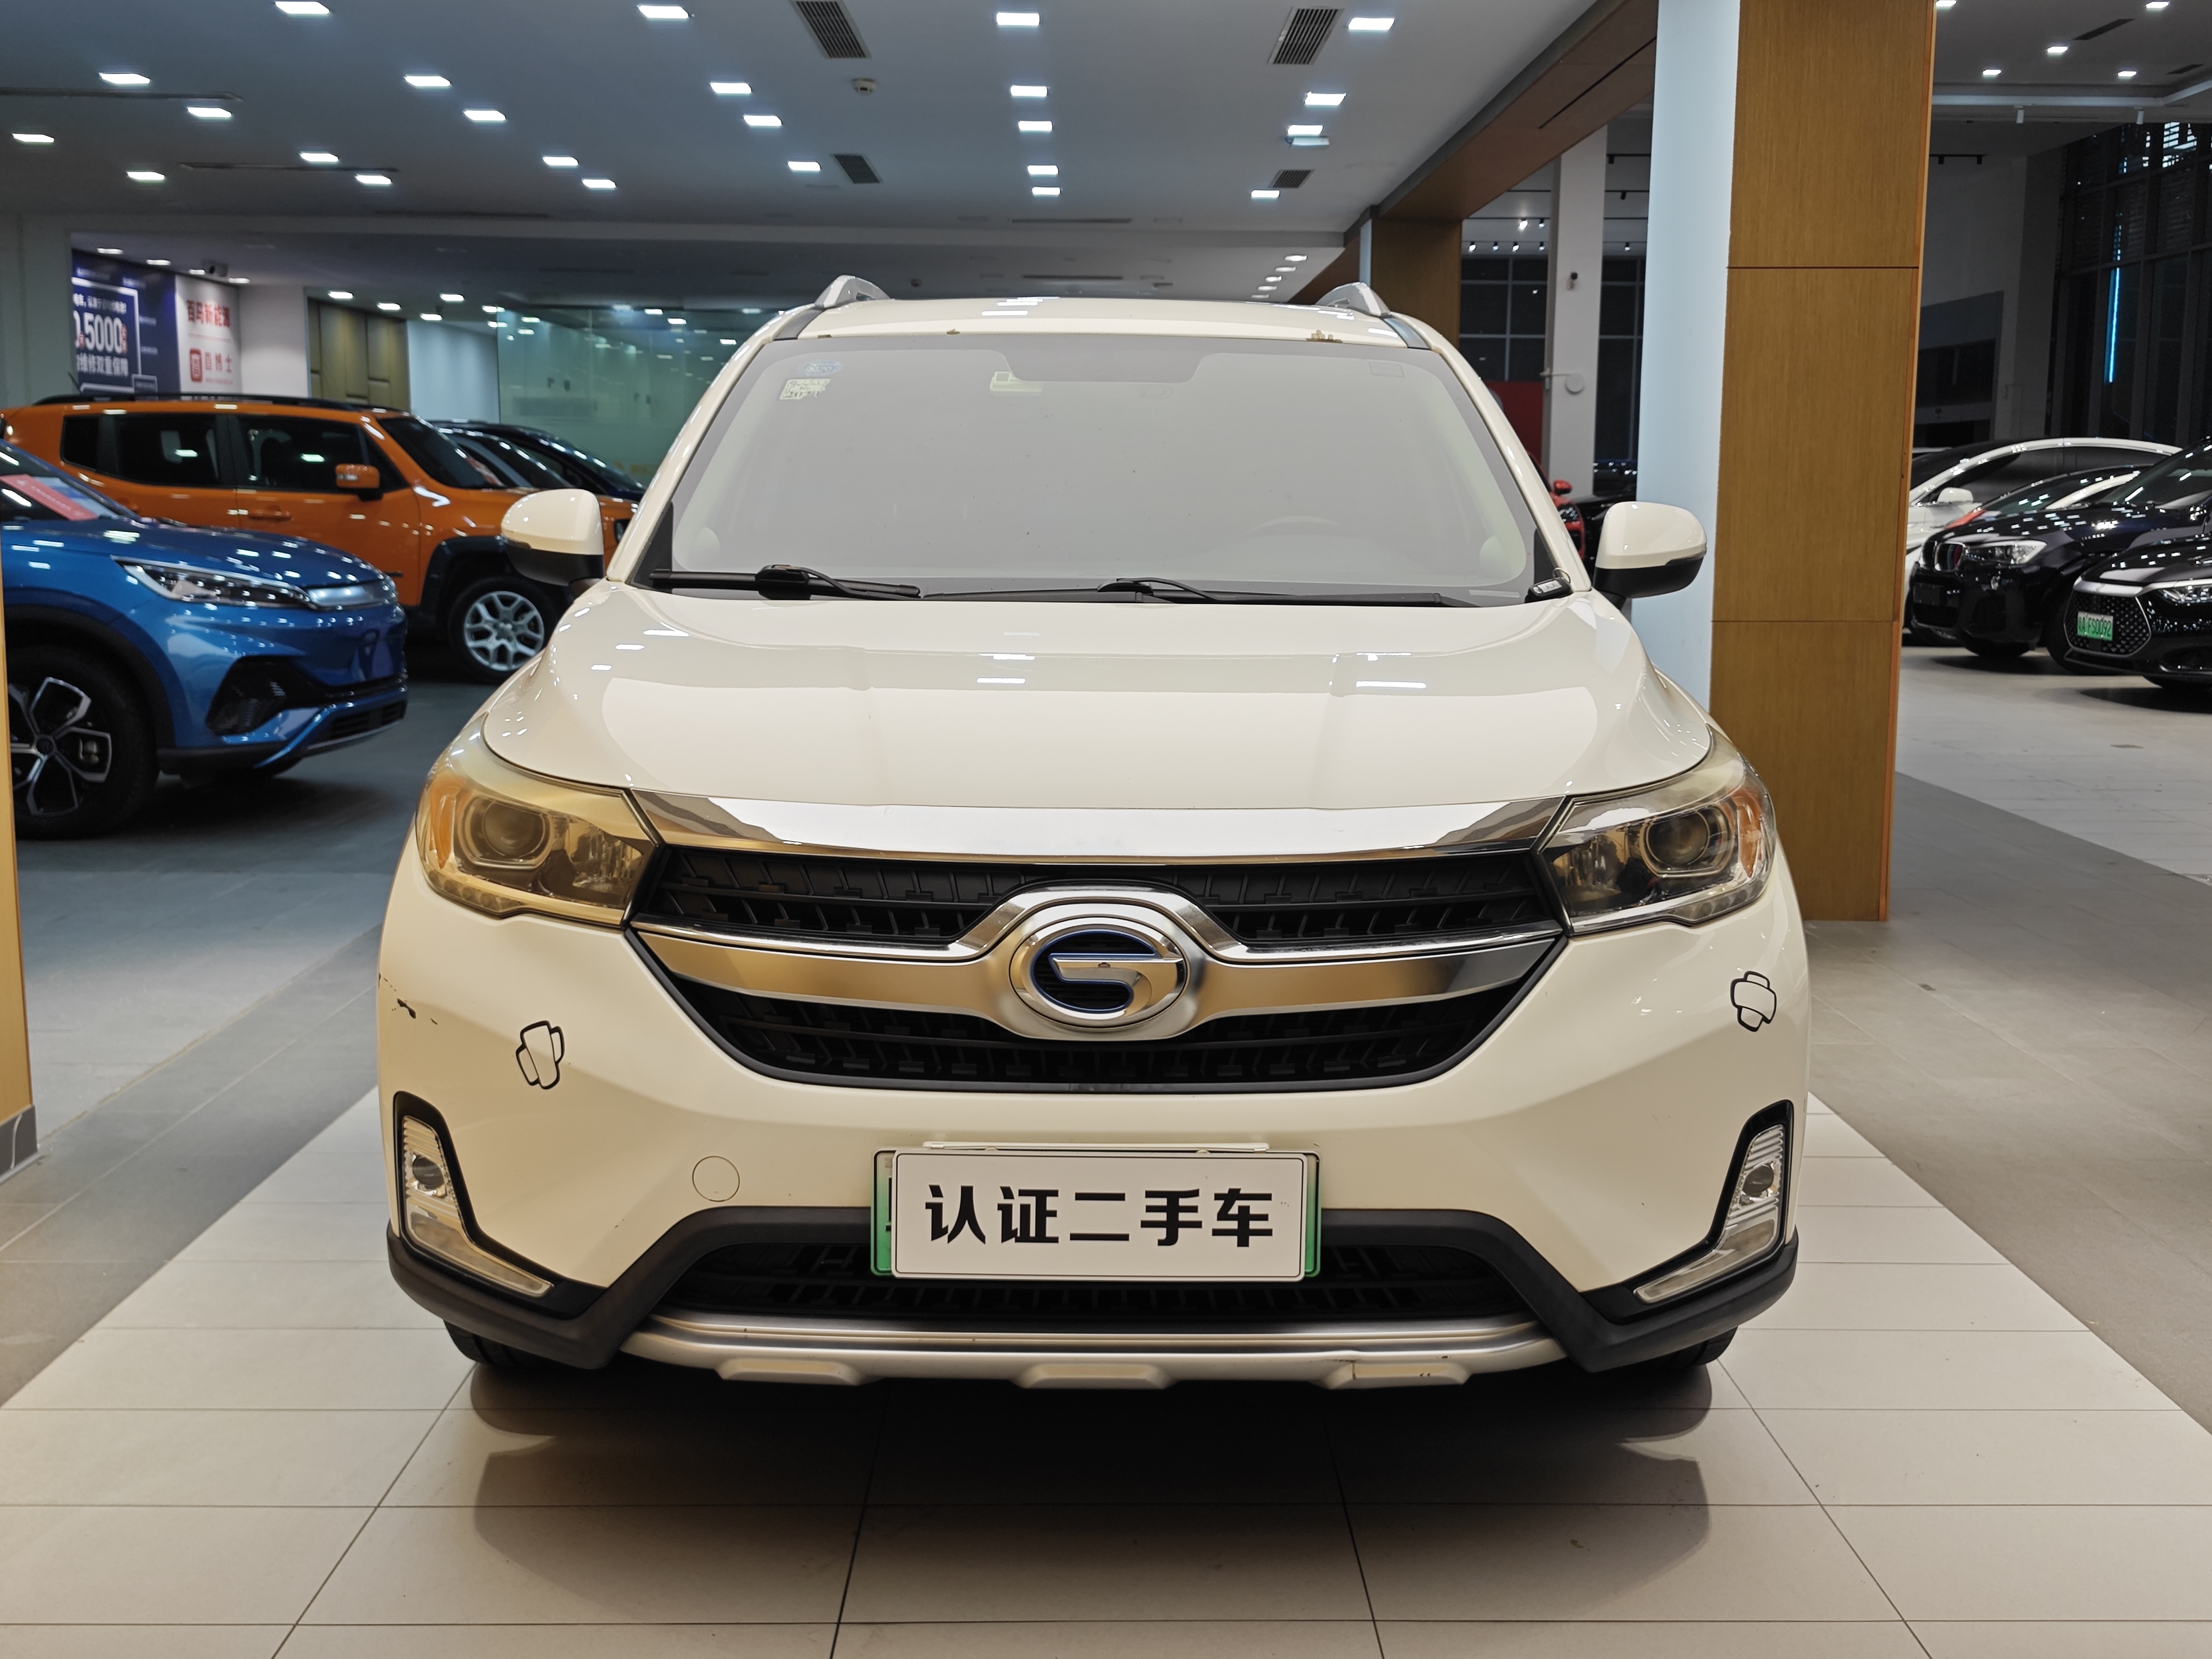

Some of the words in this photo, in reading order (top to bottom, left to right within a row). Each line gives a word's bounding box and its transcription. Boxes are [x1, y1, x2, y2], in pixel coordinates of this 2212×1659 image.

[925, 1184, 1273, 1248] 认证二手车
